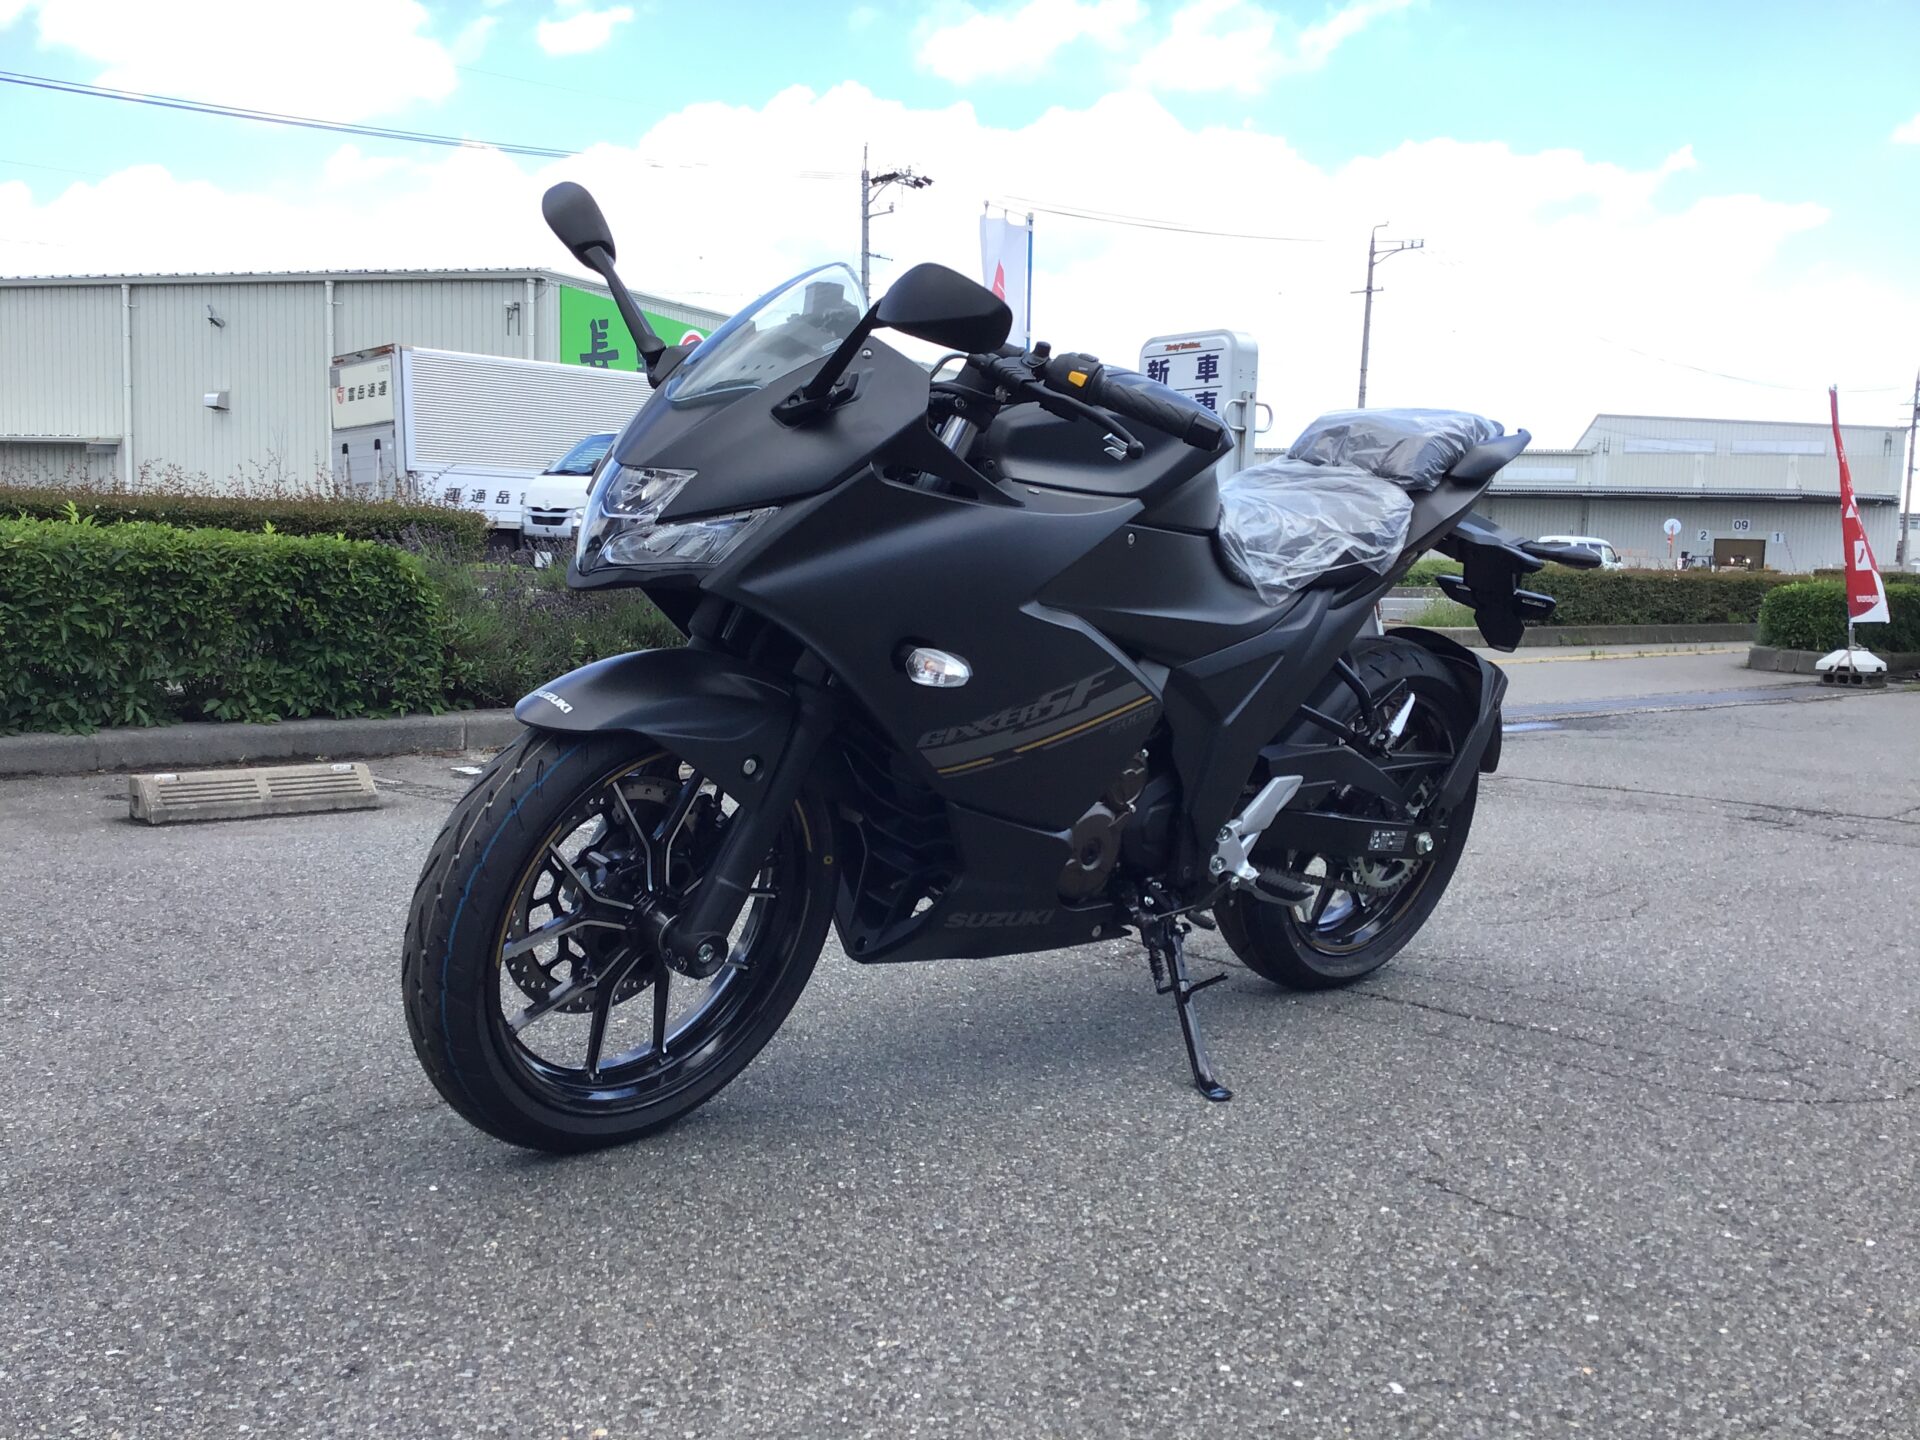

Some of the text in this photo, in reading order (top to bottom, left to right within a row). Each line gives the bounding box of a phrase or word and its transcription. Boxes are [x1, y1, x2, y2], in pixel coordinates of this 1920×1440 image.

[1734, 520, 1749, 530] 09
[1700, 531, 1707, 540] 2
[1775, 533, 1780, 541] 1
[533, 690, 573, 714] SUZUKI
[944, 908, 1056, 928] SUZUKI
